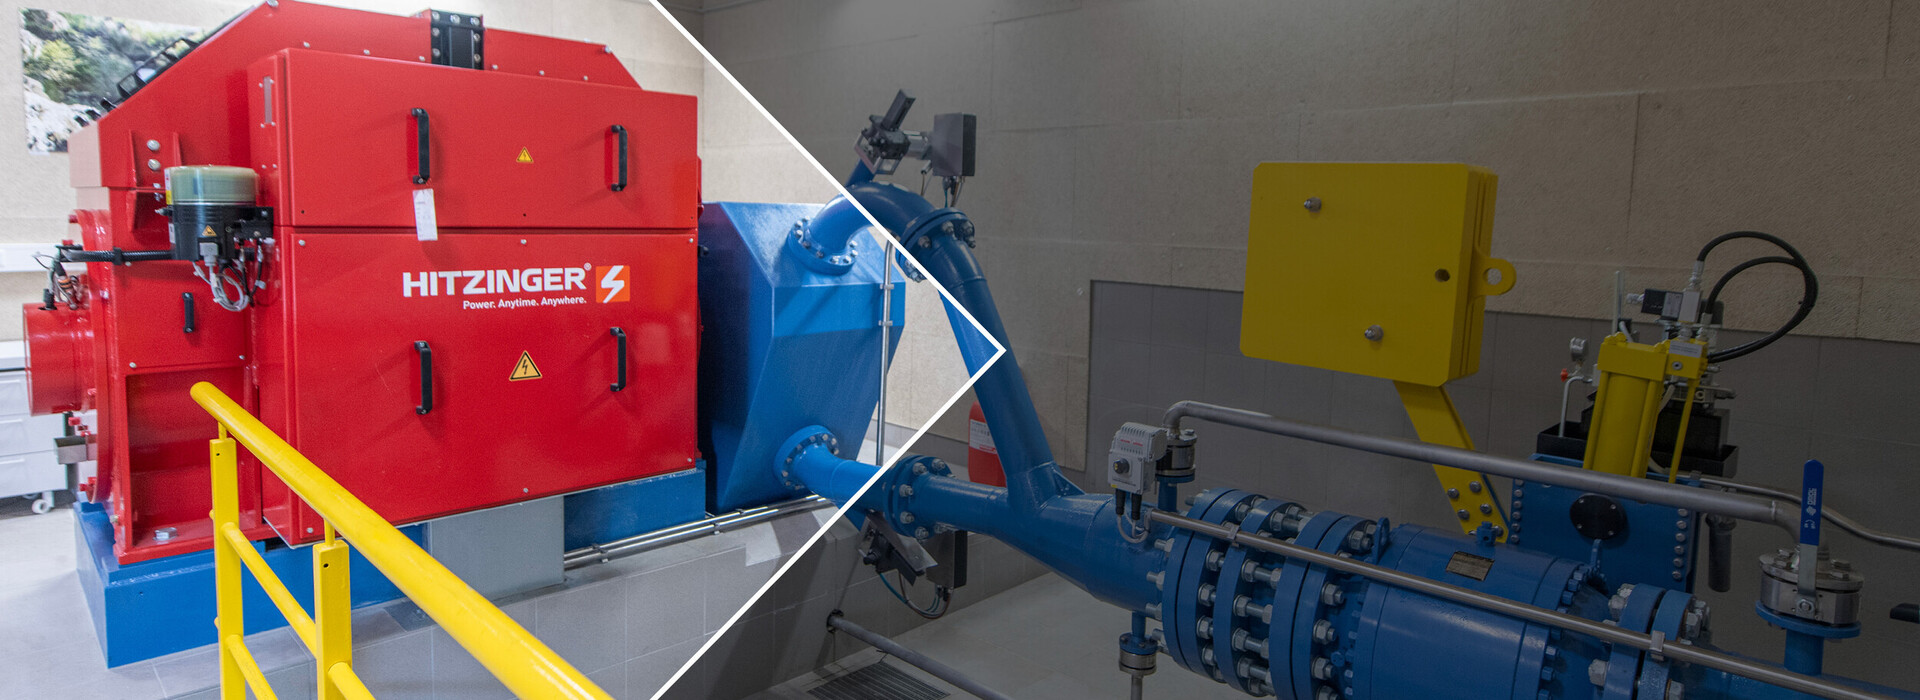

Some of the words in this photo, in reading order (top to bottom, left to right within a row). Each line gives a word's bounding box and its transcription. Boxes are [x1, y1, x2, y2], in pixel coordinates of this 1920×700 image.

[402, 267, 587, 297] HITZINGER
[463, 299, 497, 310] Power.
[498, 297, 540, 309] Anytime.
[541, 295, 587, 307] Anywhere.
